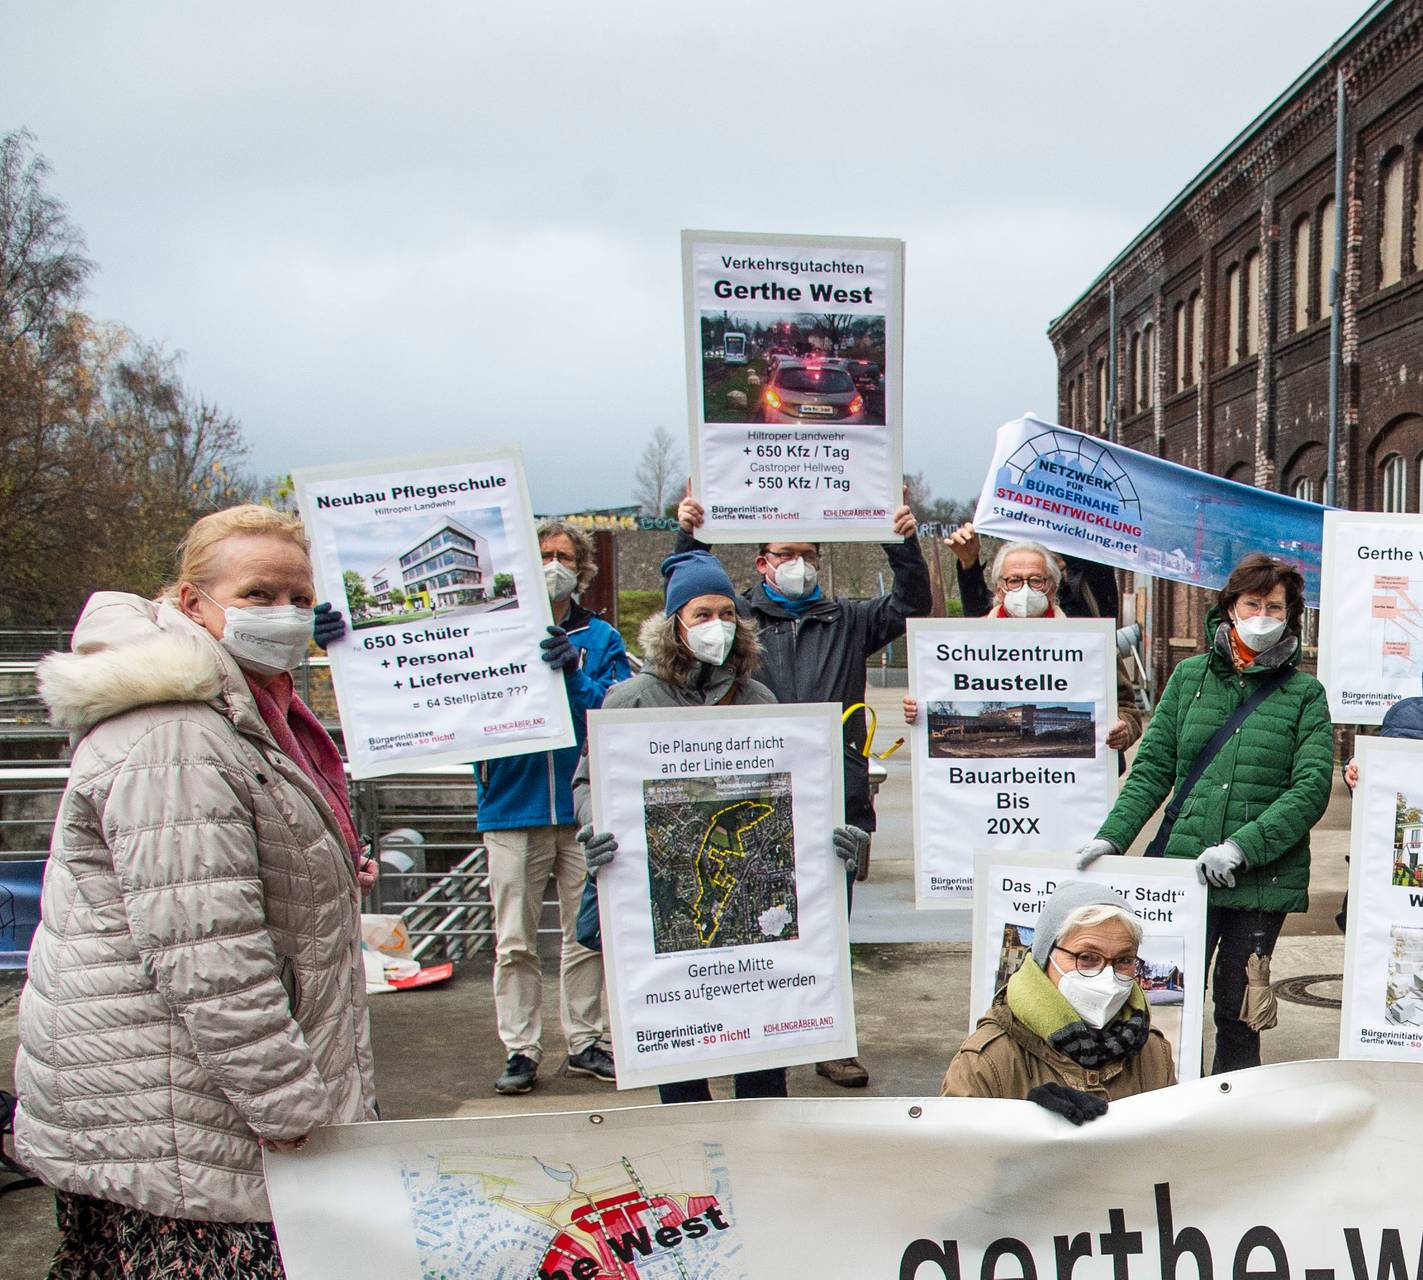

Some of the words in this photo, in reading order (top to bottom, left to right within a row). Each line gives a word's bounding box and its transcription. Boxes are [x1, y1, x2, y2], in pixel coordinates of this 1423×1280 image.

[722, 256, 864, 274] Verkehrsgutachten
[714, 280, 801, 301] Gerthe
[810, 284, 873, 304] West
[748, 431, 792, 442] Hiltroper
[795, 432, 845, 441] Landwehr
[743, 447, 752, 455] +
[757, 446, 782, 457] 650
[788, 445, 810, 457] Kfz
[823, 446, 850, 460] Tag
[750, 463, 800, 474] Castroper
[804, 463, 844, 474] Hellweg
[1039, 459, 1113, 491] NETZWERK
[316, 491, 386, 509] Neubau
[391, 475, 507, 501] Pflegeschule
[745, 479, 753, 487] +
[758, 477, 783, 489] 550
[788, 477, 811, 489] Kfz
[824, 477, 850, 491] Tag
[1066, 480, 1084, 492] FÜR
[1025, 479, 1120, 515] BÜRGERNAHE
[374, 504, 412, 516] Hiltroper
[414, 499, 456, 512] Landwehr
[712, 505, 778, 514] Bürgerinitiative
[775, 512, 800, 520] nicht!
[996, 488, 1142, 537] STADTENTWICKLUNG
[993, 506, 1138, 553] stadtentwicklung.net
[1357, 546, 1413, 561] Gerthe
[364, 635, 396, 650] 650
[403, 626, 470, 644] Schüler
[381, 659, 390, 669] +
[397, 647, 475, 668] Personal
[936, 644, 1083, 662] Schulzentrum
[393, 680, 403, 689] +
[410, 663, 527, 689] Lieferverkehr
[954, 674, 1068, 691] Baustelle
[427, 698, 441, 709] 64
[444, 690, 504, 707] Stellplätze
[507, 685, 528, 697] ???
[1342, 691, 1402, 700] Bürgerinitiative
[369, 729, 434, 746] Bürgerinitiative
[432, 732, 456, 743] nicht!
[650, 741, 670, 754] Die
[674, 738, 722, 755] Planung
[726, 737, 750, 750] darf
[753, 736, 784, 749] nicht
[661, 763, 676, 774] an
[680, 759, 700, 772] der
[704, 758, 732, 771] Linie
[736, 757, 775, 770] enden
[950, 767, 1076, 784] Bauarbeiten
[997, 792, 1030, 809] Bis
[987, 818, 1040, 835] 20XX
[931, 877, 974, 886] Bürgerinit
[1002, 878, 1031, 893] Das
[1134, 908, 1173, 923] sicht
[688, 961, 735, 978] Gerthe
[739, 958, 774, 972] Mitte
[646, 990, 681, 1005] muss
[684, 978, 764, 1000] aufgewertet
[767, 974, 816, 988] werden
[636, 1022, 723, 1042] Bürgerinitiative
[637, 1040, 669, 1053] Gerthe
[671, 1037, 695, 1049] West
[703, 1033, 717, 1045] so
[720, 1028, 751, 1042] nicht!
[1360, 1037, 1385, 1046] Gerthe
[1386, 1039, 1405, 1047] West
[1410, 1040, 1422, 1049] so
[607, 1205, 729, 1264] West
